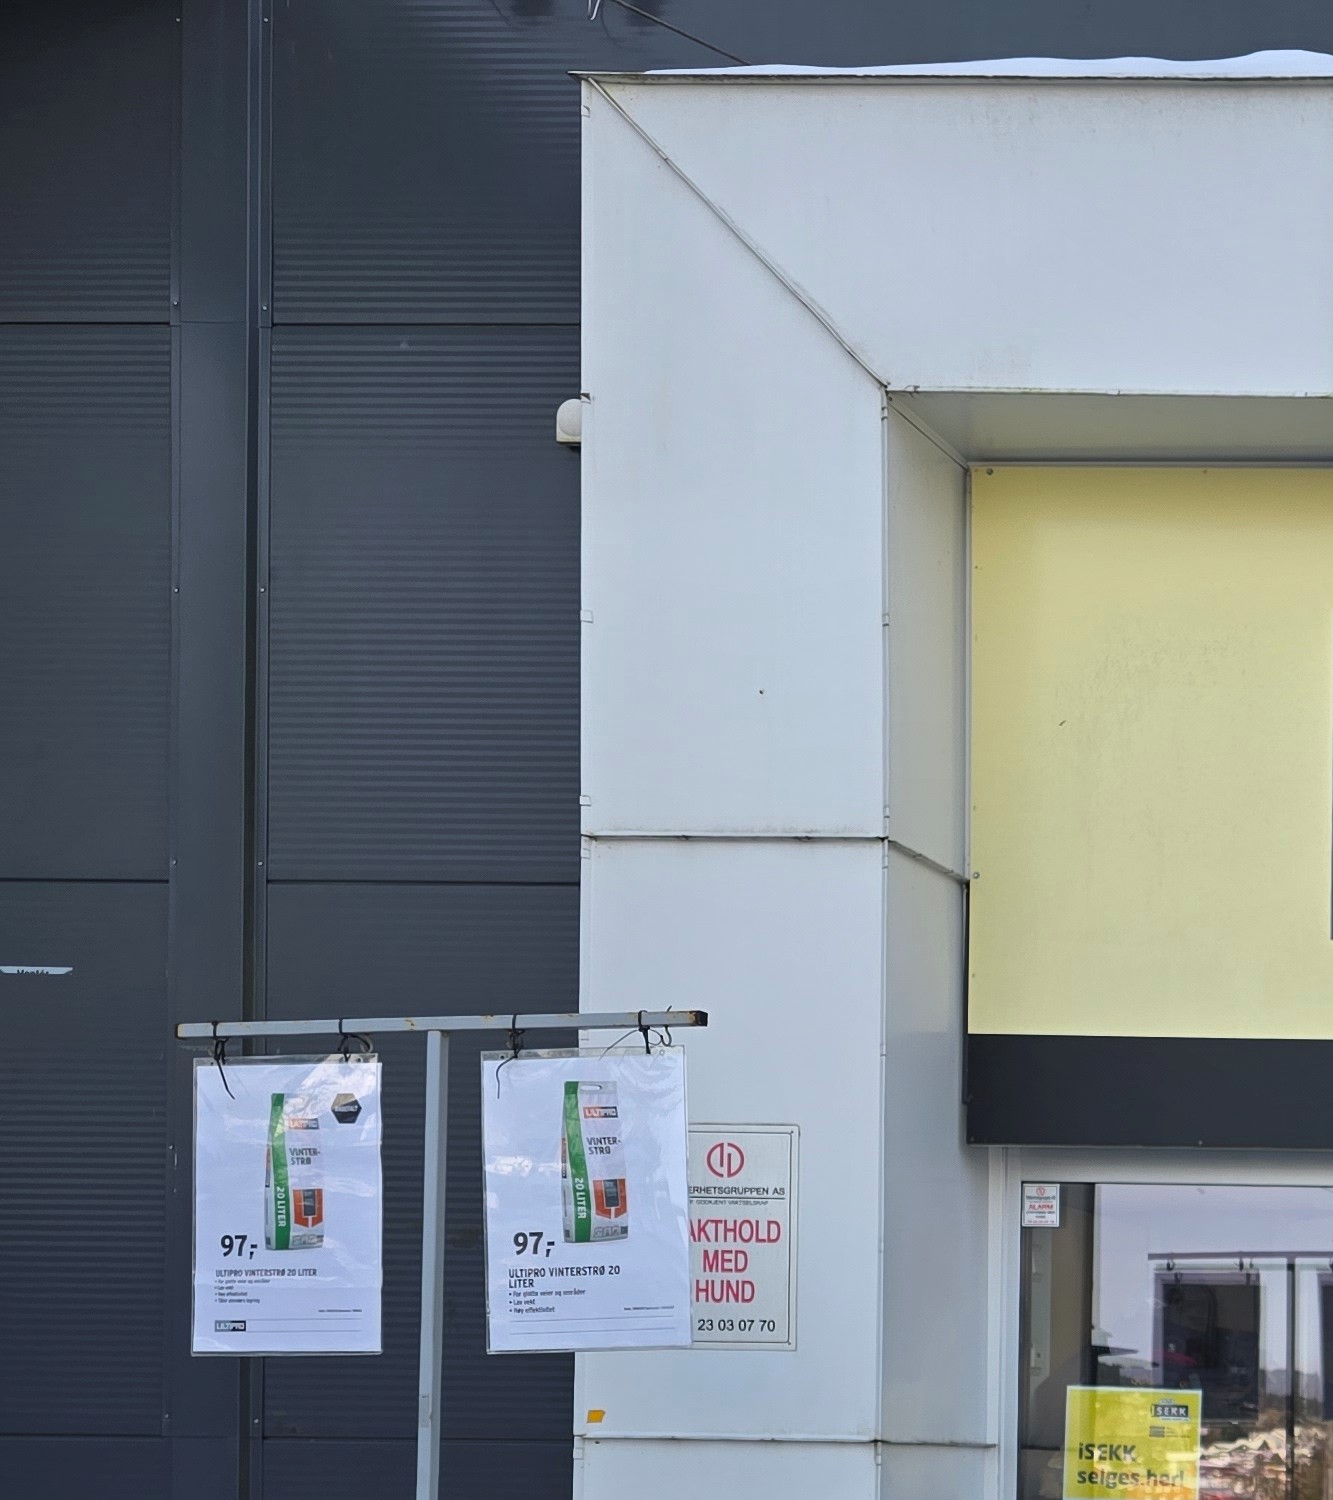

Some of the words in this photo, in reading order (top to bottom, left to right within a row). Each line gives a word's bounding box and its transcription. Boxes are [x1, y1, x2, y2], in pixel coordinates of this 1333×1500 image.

[574, 1177, 584, 1190] 20
[772, 1187, 785, 1196] AS
[277, 1200, 287, 1227] LITER
[576, 1192, 587, 1219] LITER
[220, 1234, 258, 1260] 97,-
[513, 1231, 555, 1258] 97,-
[703, 1249, 748, 1273] MED
[216, 1269, 243, 1277] ULTIPRO
[244, 1268, 286, 1277] VINTERSTRØ
[287, 1269, 296, 1277] 20
[298, 1268, 318, 1277] LITER
[508, 1267, 546, 1278] ULTIPRO
[549, 1266, 605, 1277] VINTERSTRØ
[608, 1265, 621, 1275] 20
[508, 1278, 534, 1288] LITER
[695, 1279, 755, 1304] HUND
[697, 1319, 714, 1332] 23
[717, 1319, 734, 1332] 03
[738, 1319, 755, 1332] 07
[759, 1319, 776, 1332] 70
[1078, 1442, 1136, 1462] iSEKK
[1077, 1469, 1140, 1489] selges
